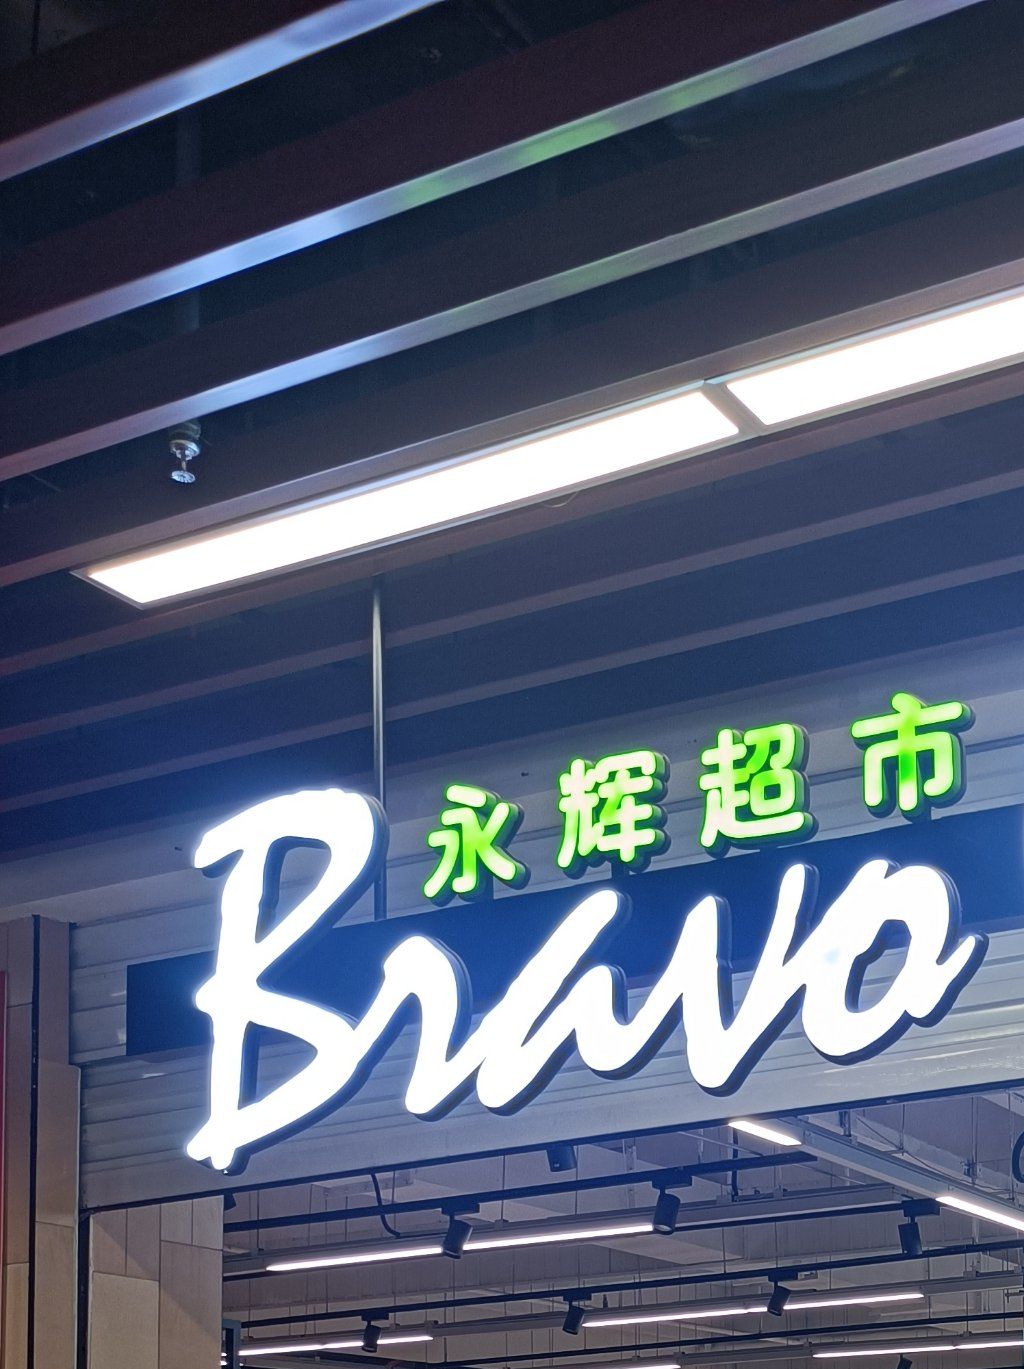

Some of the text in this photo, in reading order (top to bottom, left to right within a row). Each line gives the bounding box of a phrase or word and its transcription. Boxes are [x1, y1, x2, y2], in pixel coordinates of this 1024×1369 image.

[423, 692, 971, 902] 永辉超市
[186, 788, 986, 1172] Bravo
